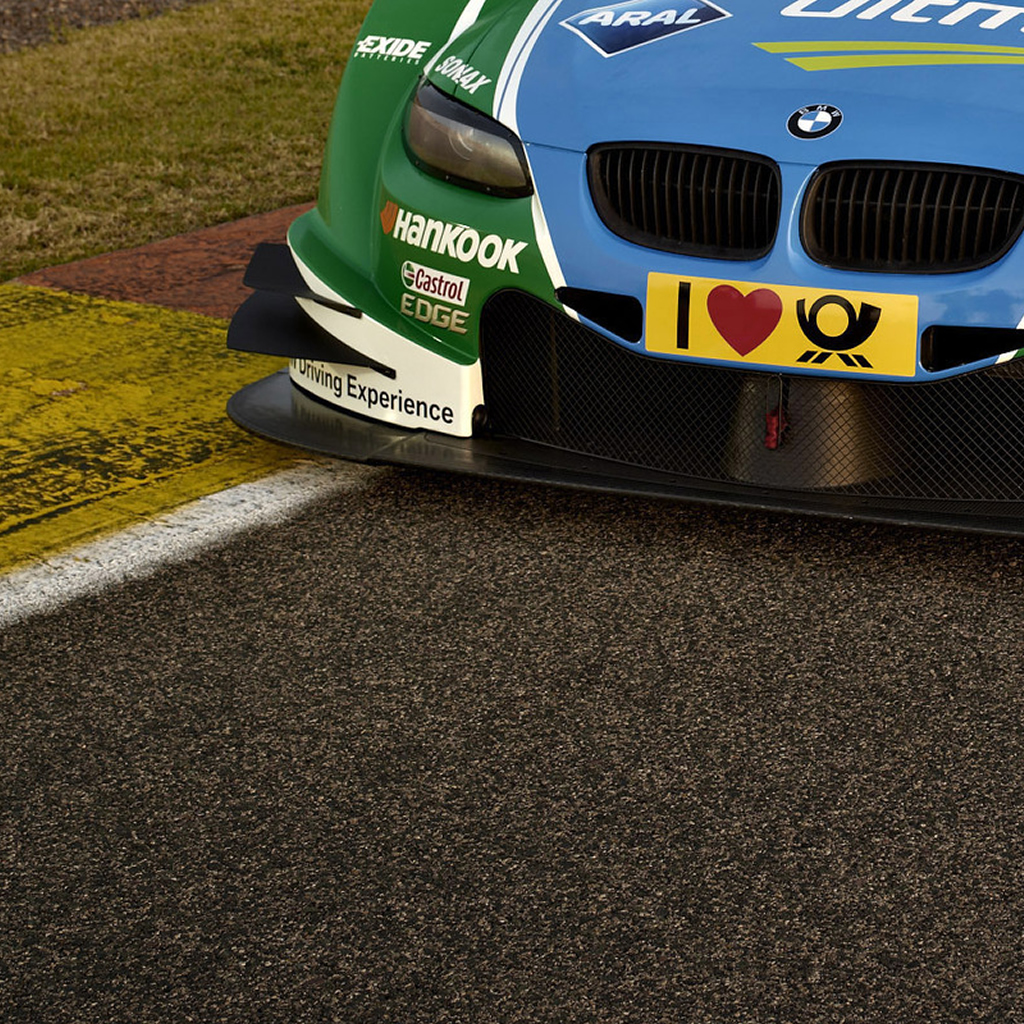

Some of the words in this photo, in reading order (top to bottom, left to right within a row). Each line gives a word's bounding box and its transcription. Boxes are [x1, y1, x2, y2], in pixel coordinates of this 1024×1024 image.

[578, 8, 702, 28] ARAL
[357, 35, 432, 59] EXIDE
[435, 56, 492, 94] SONAX
[413, 268, 464, 301] Castrol
[401, 293, 470, 334] EDGE
[299, 358, 343, 398] Driving
[347, 374, 454, 424] Experience
